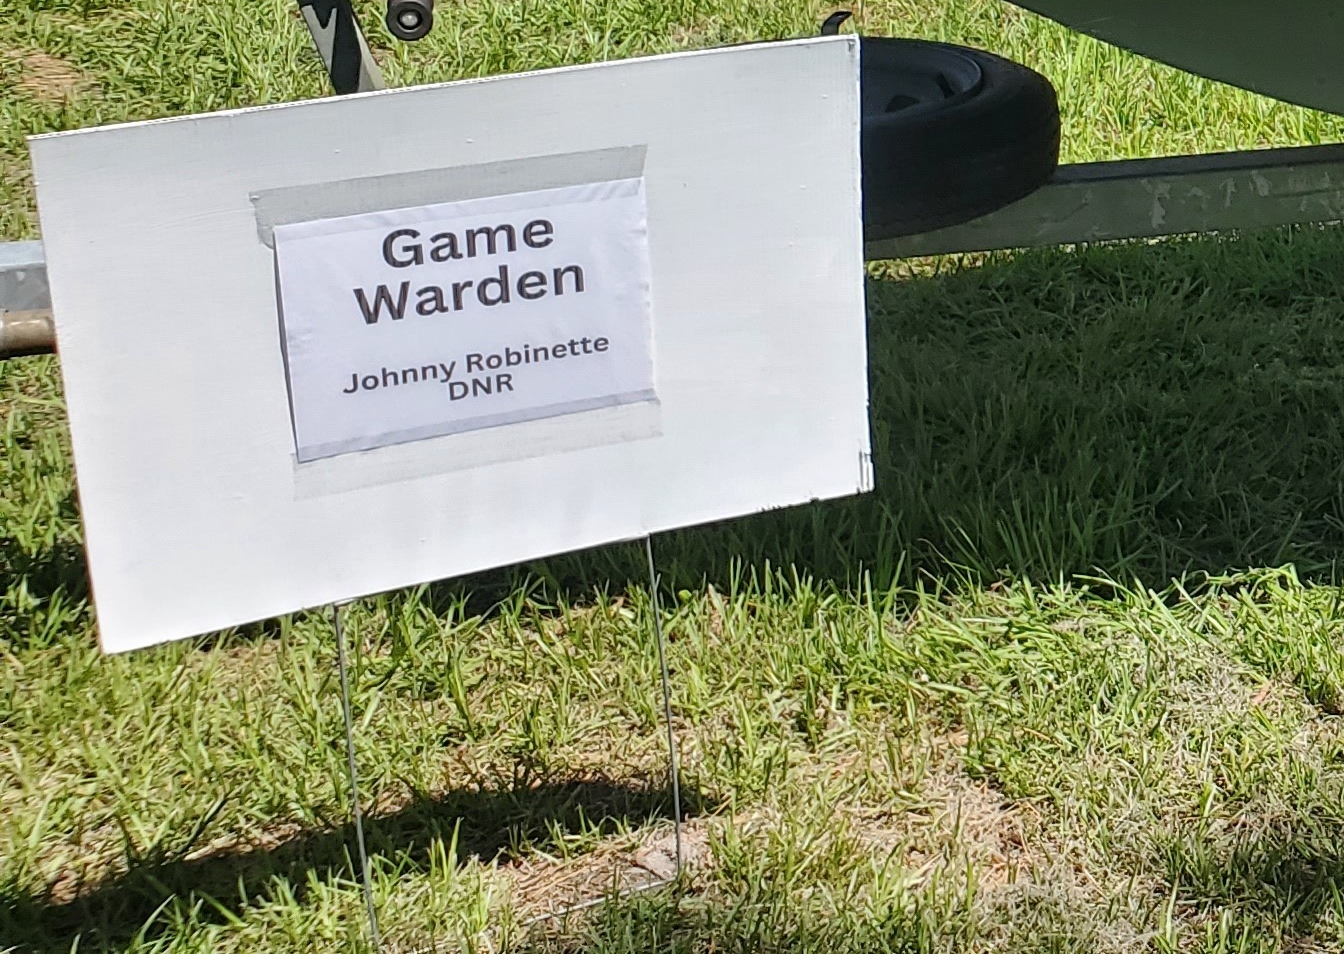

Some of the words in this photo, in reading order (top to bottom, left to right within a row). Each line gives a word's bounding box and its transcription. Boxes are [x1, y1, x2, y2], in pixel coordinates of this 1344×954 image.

[381, 218, 555, 269] Game
[353, 264, 585, 326] Warden
[343, 360, 457, 394] Johnny
[465, 336, 610, 374] Robinette
[449, 373, 514, 402] DNR
